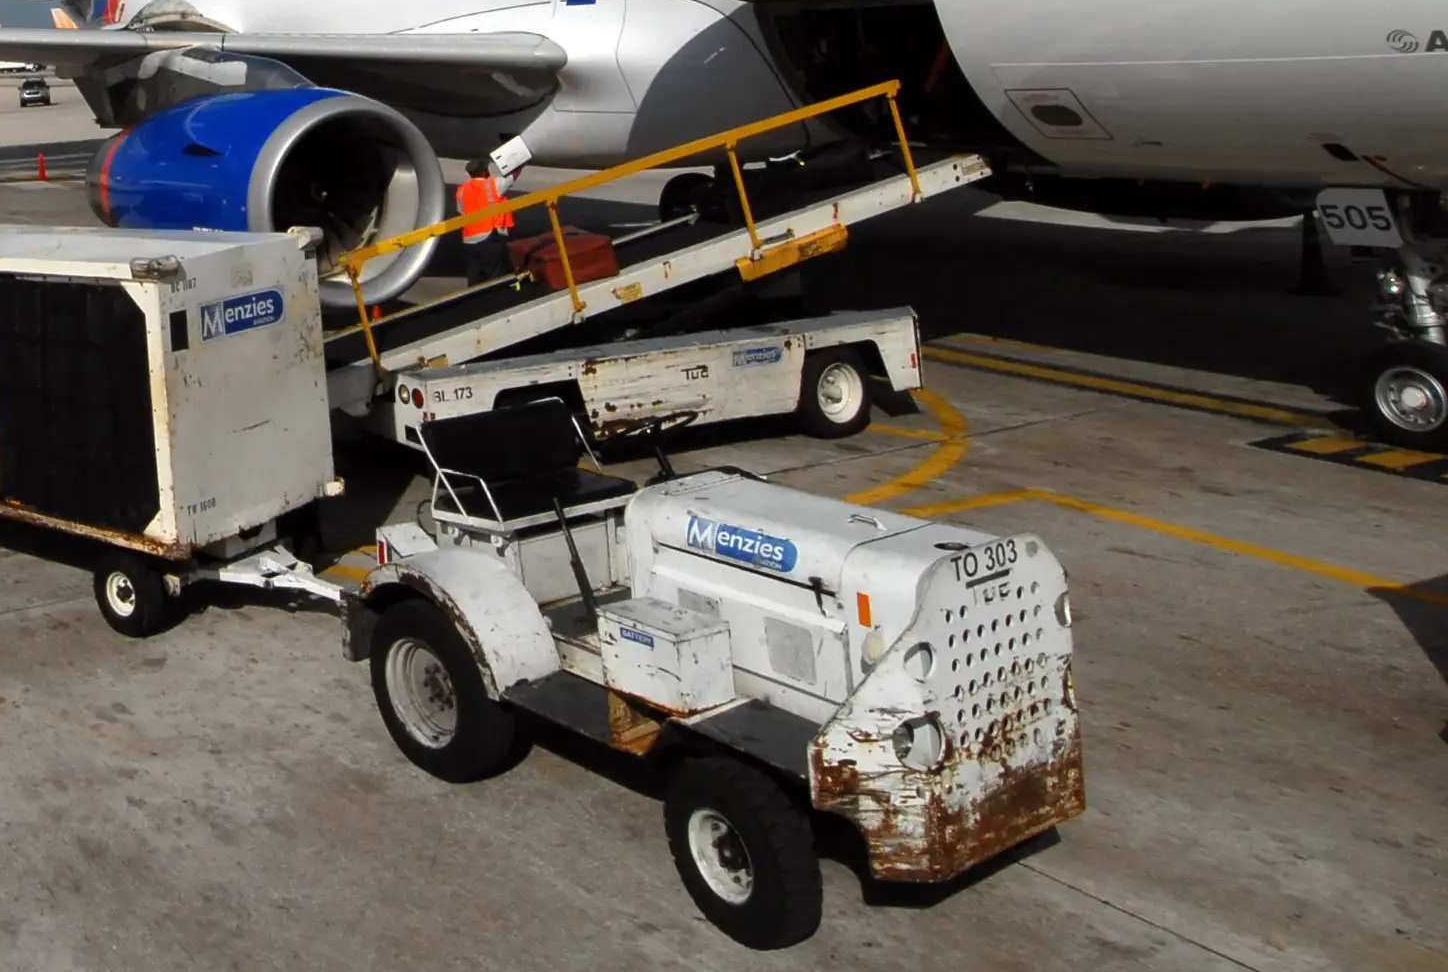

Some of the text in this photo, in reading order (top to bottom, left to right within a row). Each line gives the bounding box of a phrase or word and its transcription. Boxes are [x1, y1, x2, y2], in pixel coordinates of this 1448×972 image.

[1319, 204, 1392, 231] 505
[203, 296, 275, 338] Menzies
[453, 386, 473, 400] 173
[688, 518, 785, 562] Menzies
[950, 538, 1018, 582] TO 303
